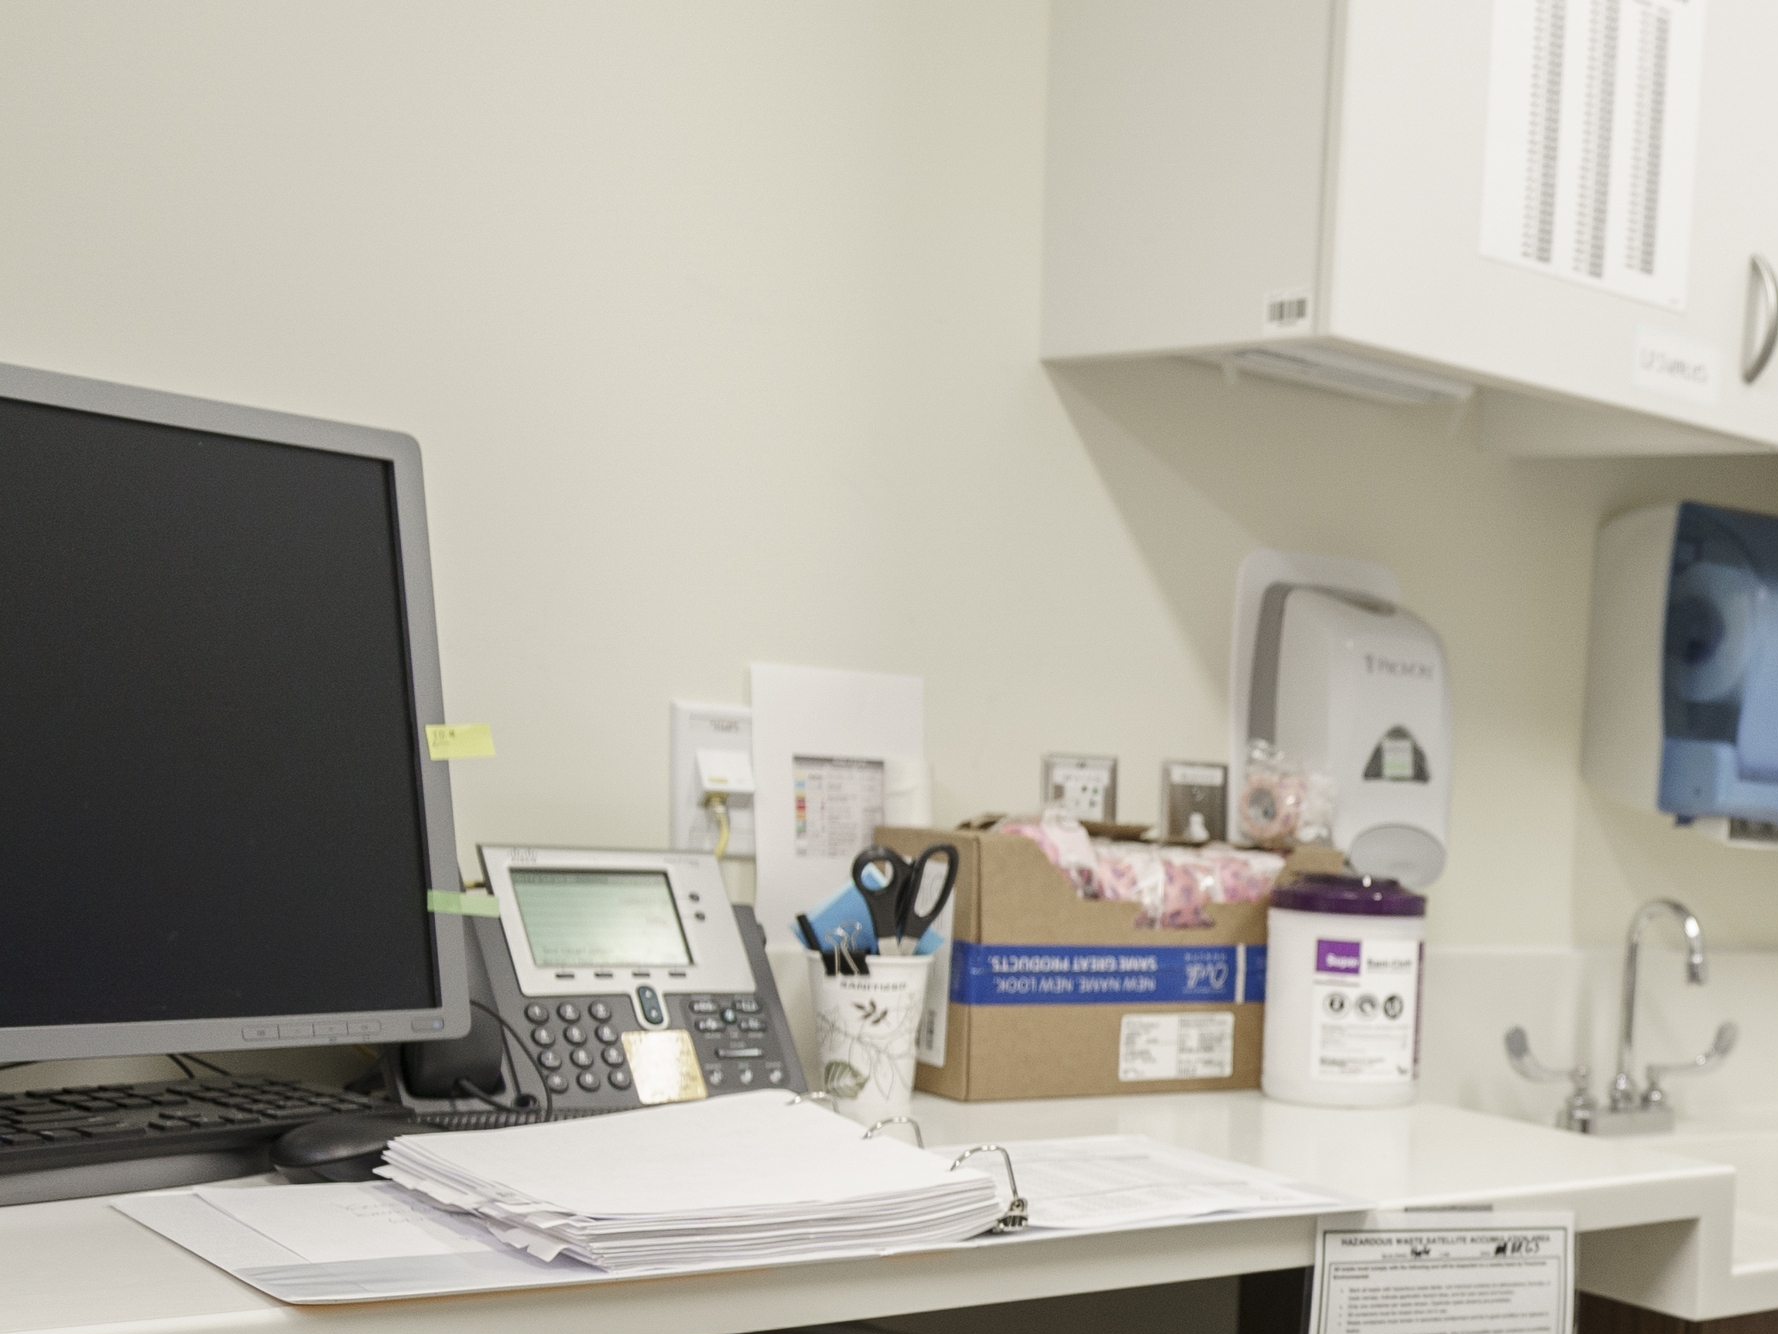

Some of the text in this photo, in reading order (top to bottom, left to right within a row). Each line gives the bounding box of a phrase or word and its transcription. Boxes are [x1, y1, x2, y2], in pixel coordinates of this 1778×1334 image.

[1073, 955, 1117, 972] GREAT
[1039, 976, 1074, 993] NEW
[1122, 976, 1157, 991] NEW
[1341, 1238, 1393, 1246] HAZARDOUS
[1396, 1237, 1424, 1246] WASTE
[1426, 1236, 1467, 1245] SATELLITE
